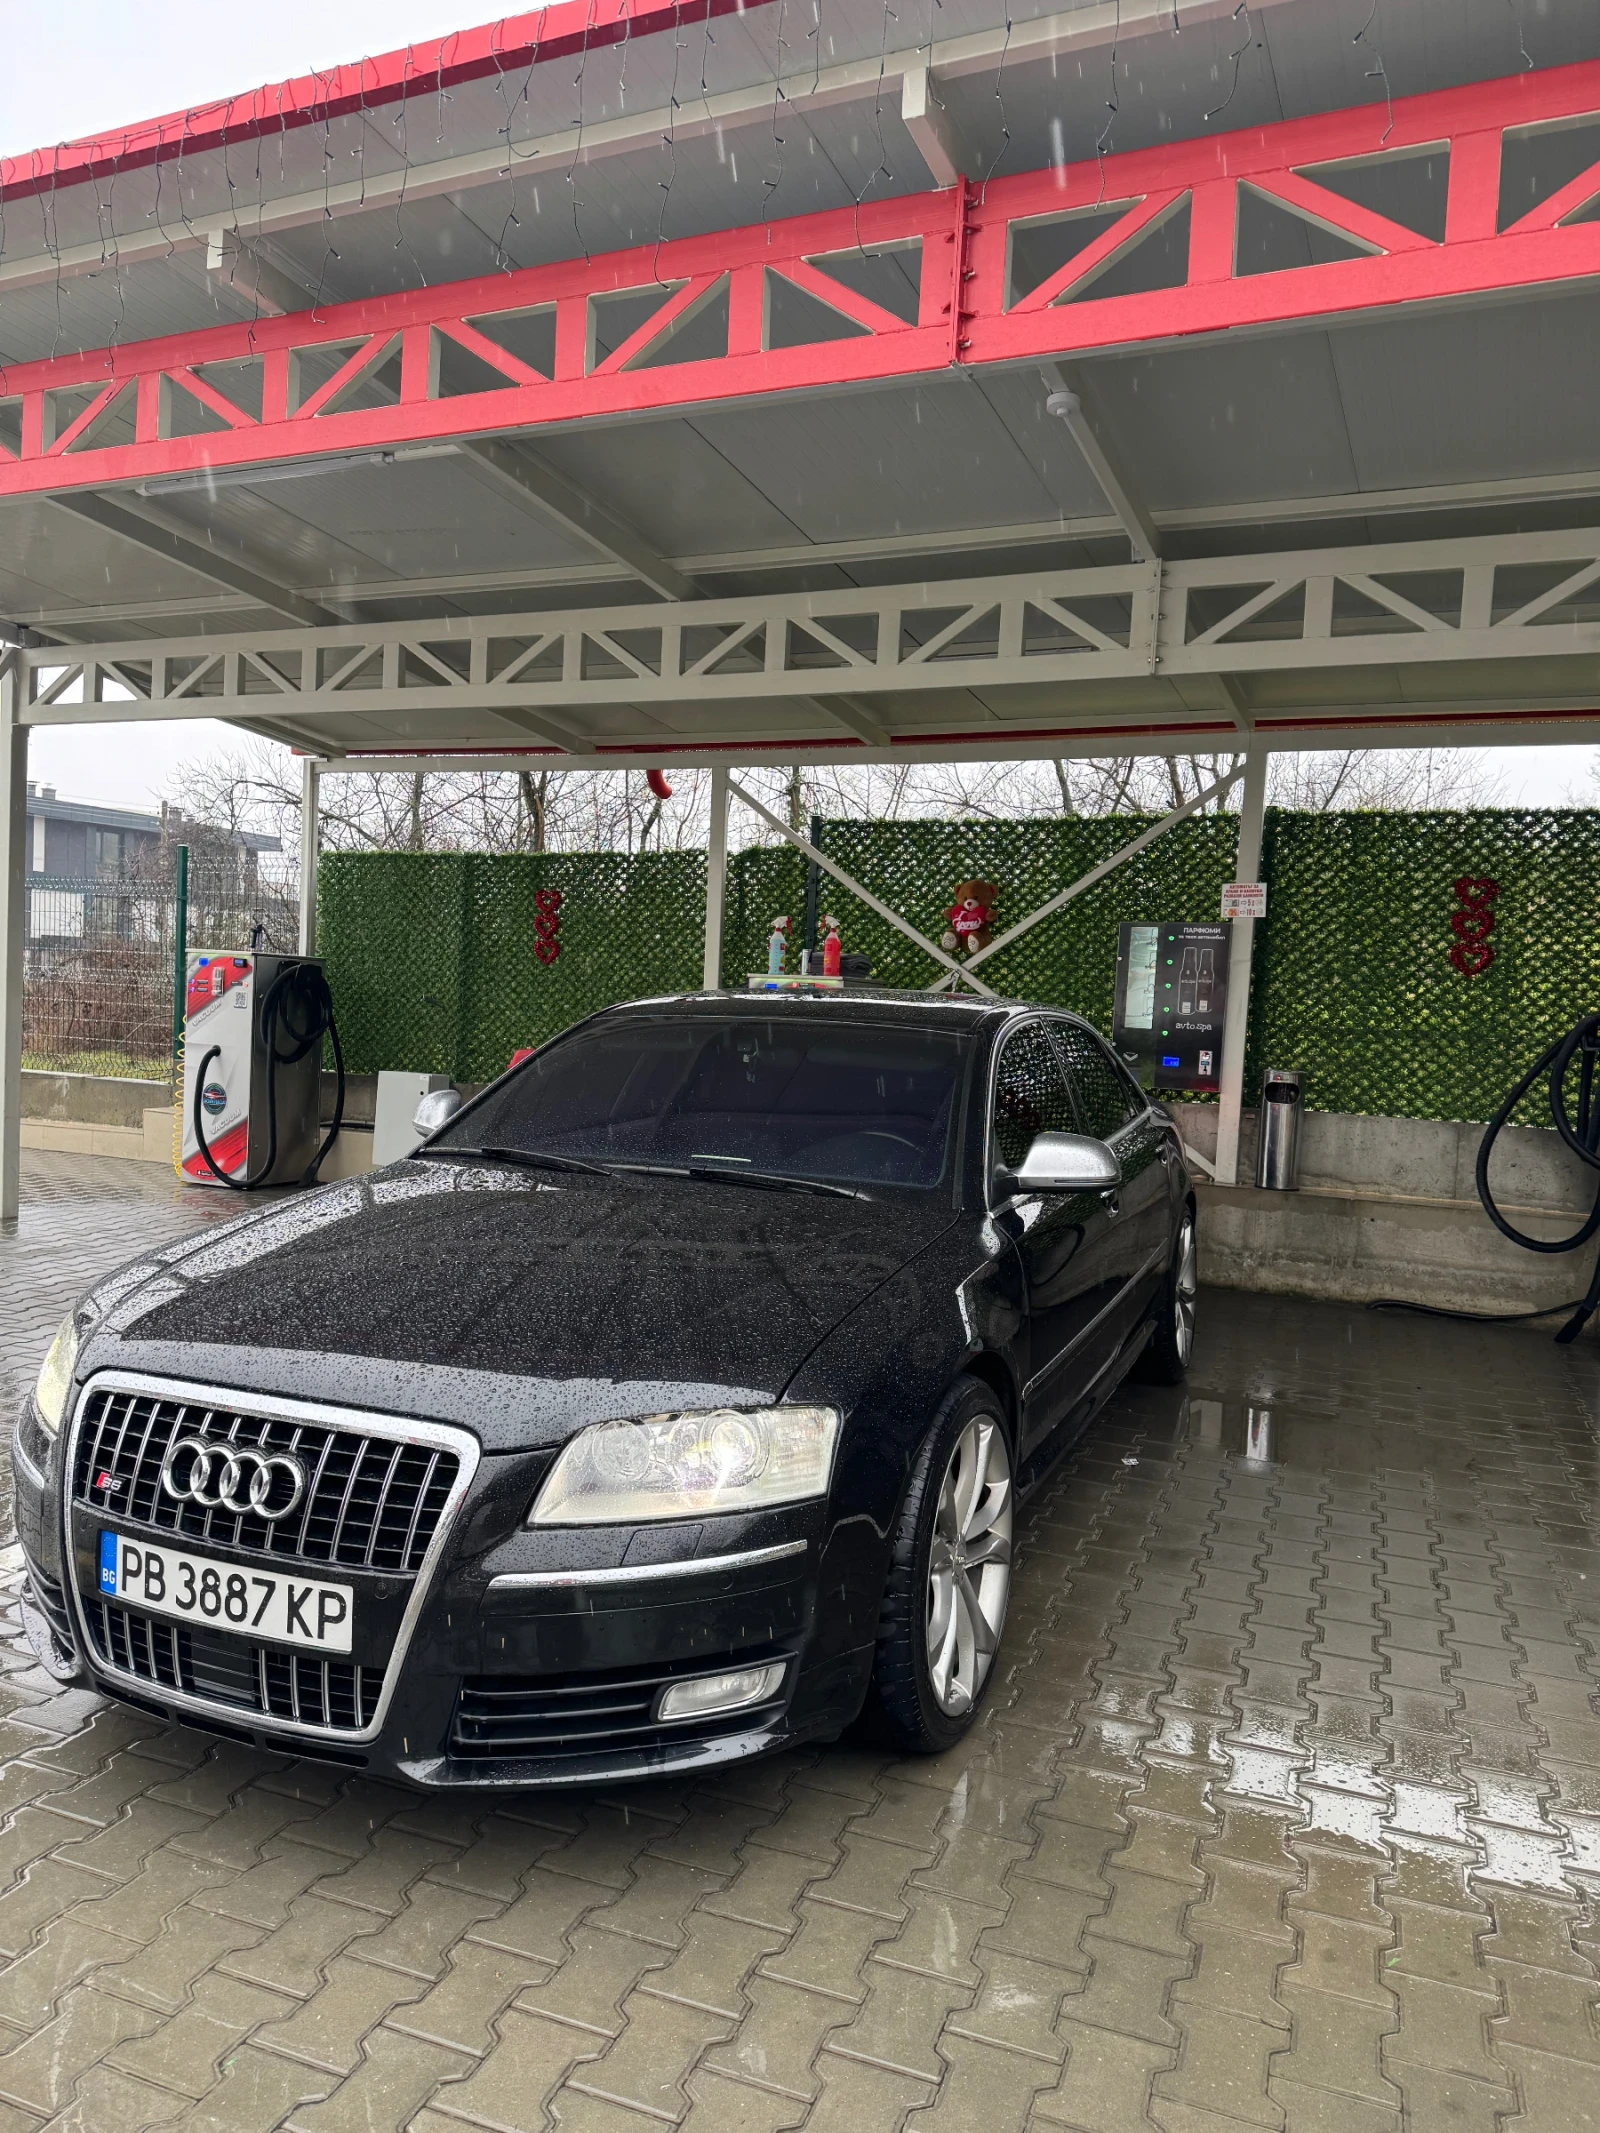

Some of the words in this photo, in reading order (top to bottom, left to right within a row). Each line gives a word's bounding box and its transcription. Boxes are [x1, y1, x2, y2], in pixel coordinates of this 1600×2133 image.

[192, 1000, 222, 1027] VACUUM
[210, 1108, 242, 1135] VACUUM
[102, 1567, 116, 1585] BG
[121, 1543, 166, 1602] PB
[175, 1561, 277, 1627] 3887
[286, 1583, 347, 1640] KP
